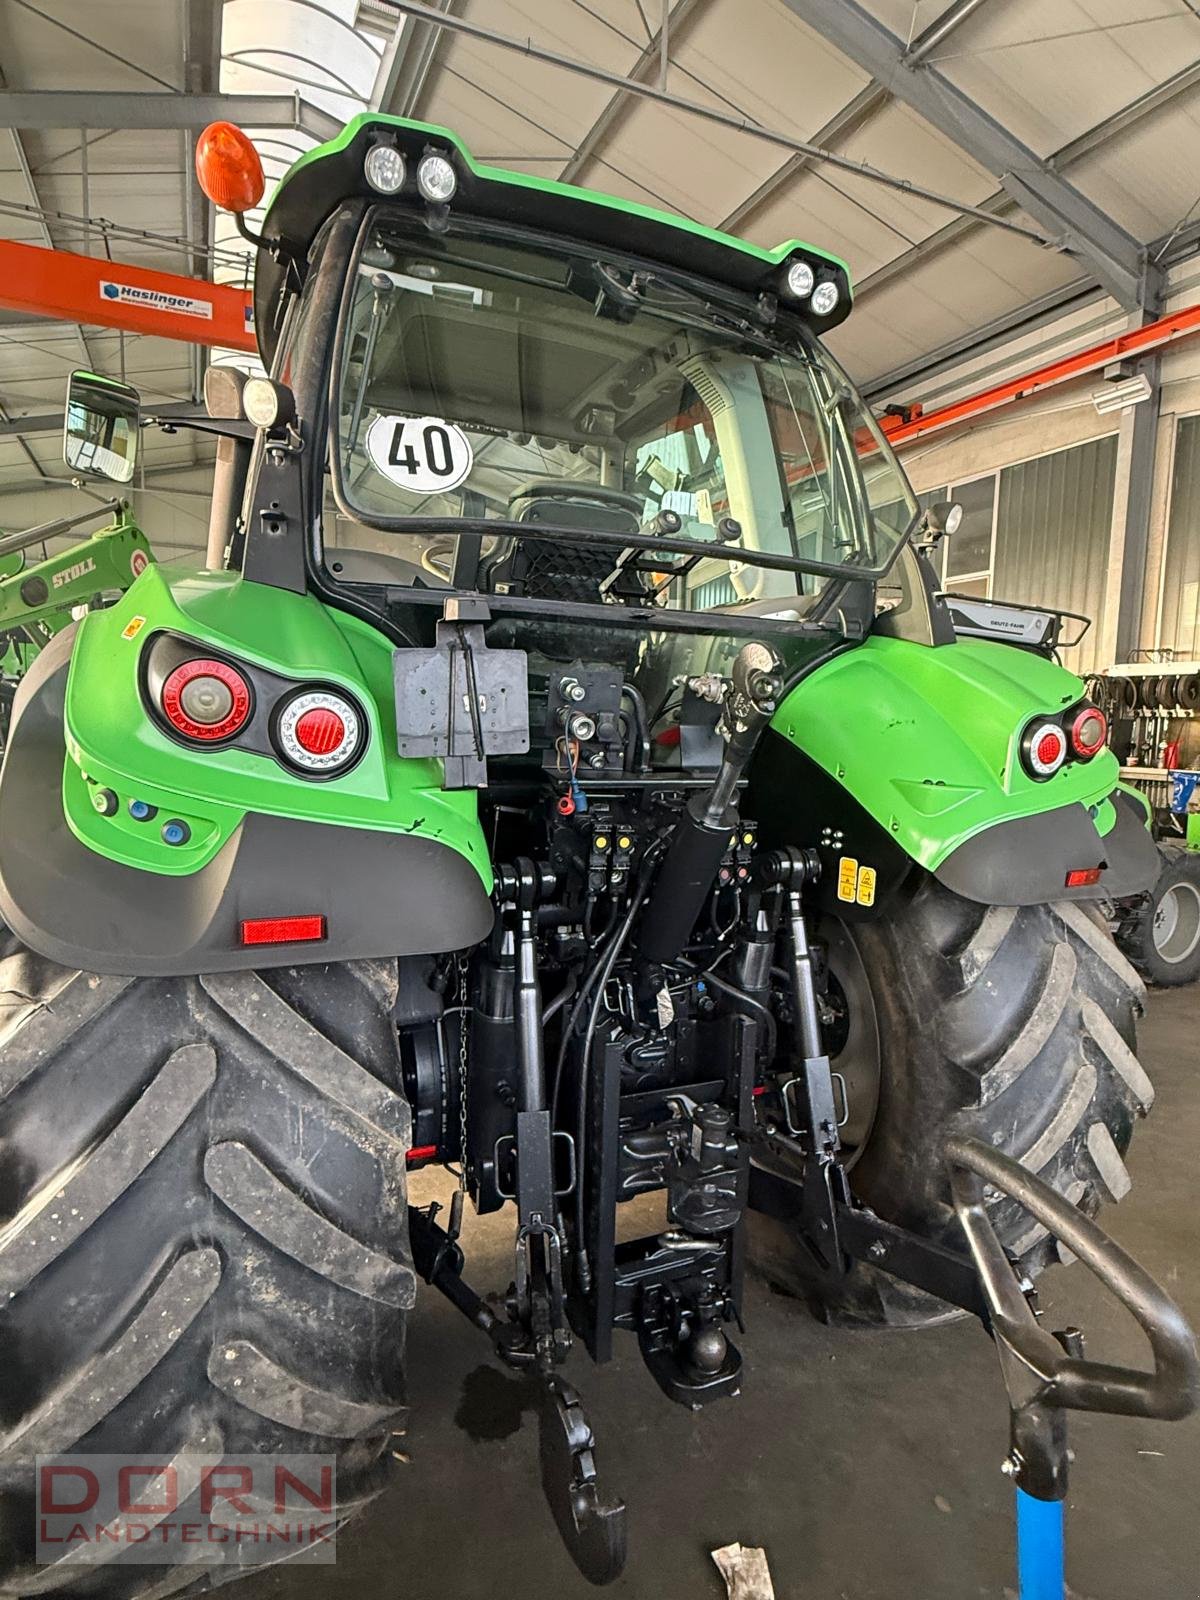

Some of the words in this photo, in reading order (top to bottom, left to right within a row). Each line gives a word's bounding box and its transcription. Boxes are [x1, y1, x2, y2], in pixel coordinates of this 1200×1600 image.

[121, 287, 193, 307] Haslinger
[388, 422, 454, 476] 40
[52, 557, 97, 589] STOLL
